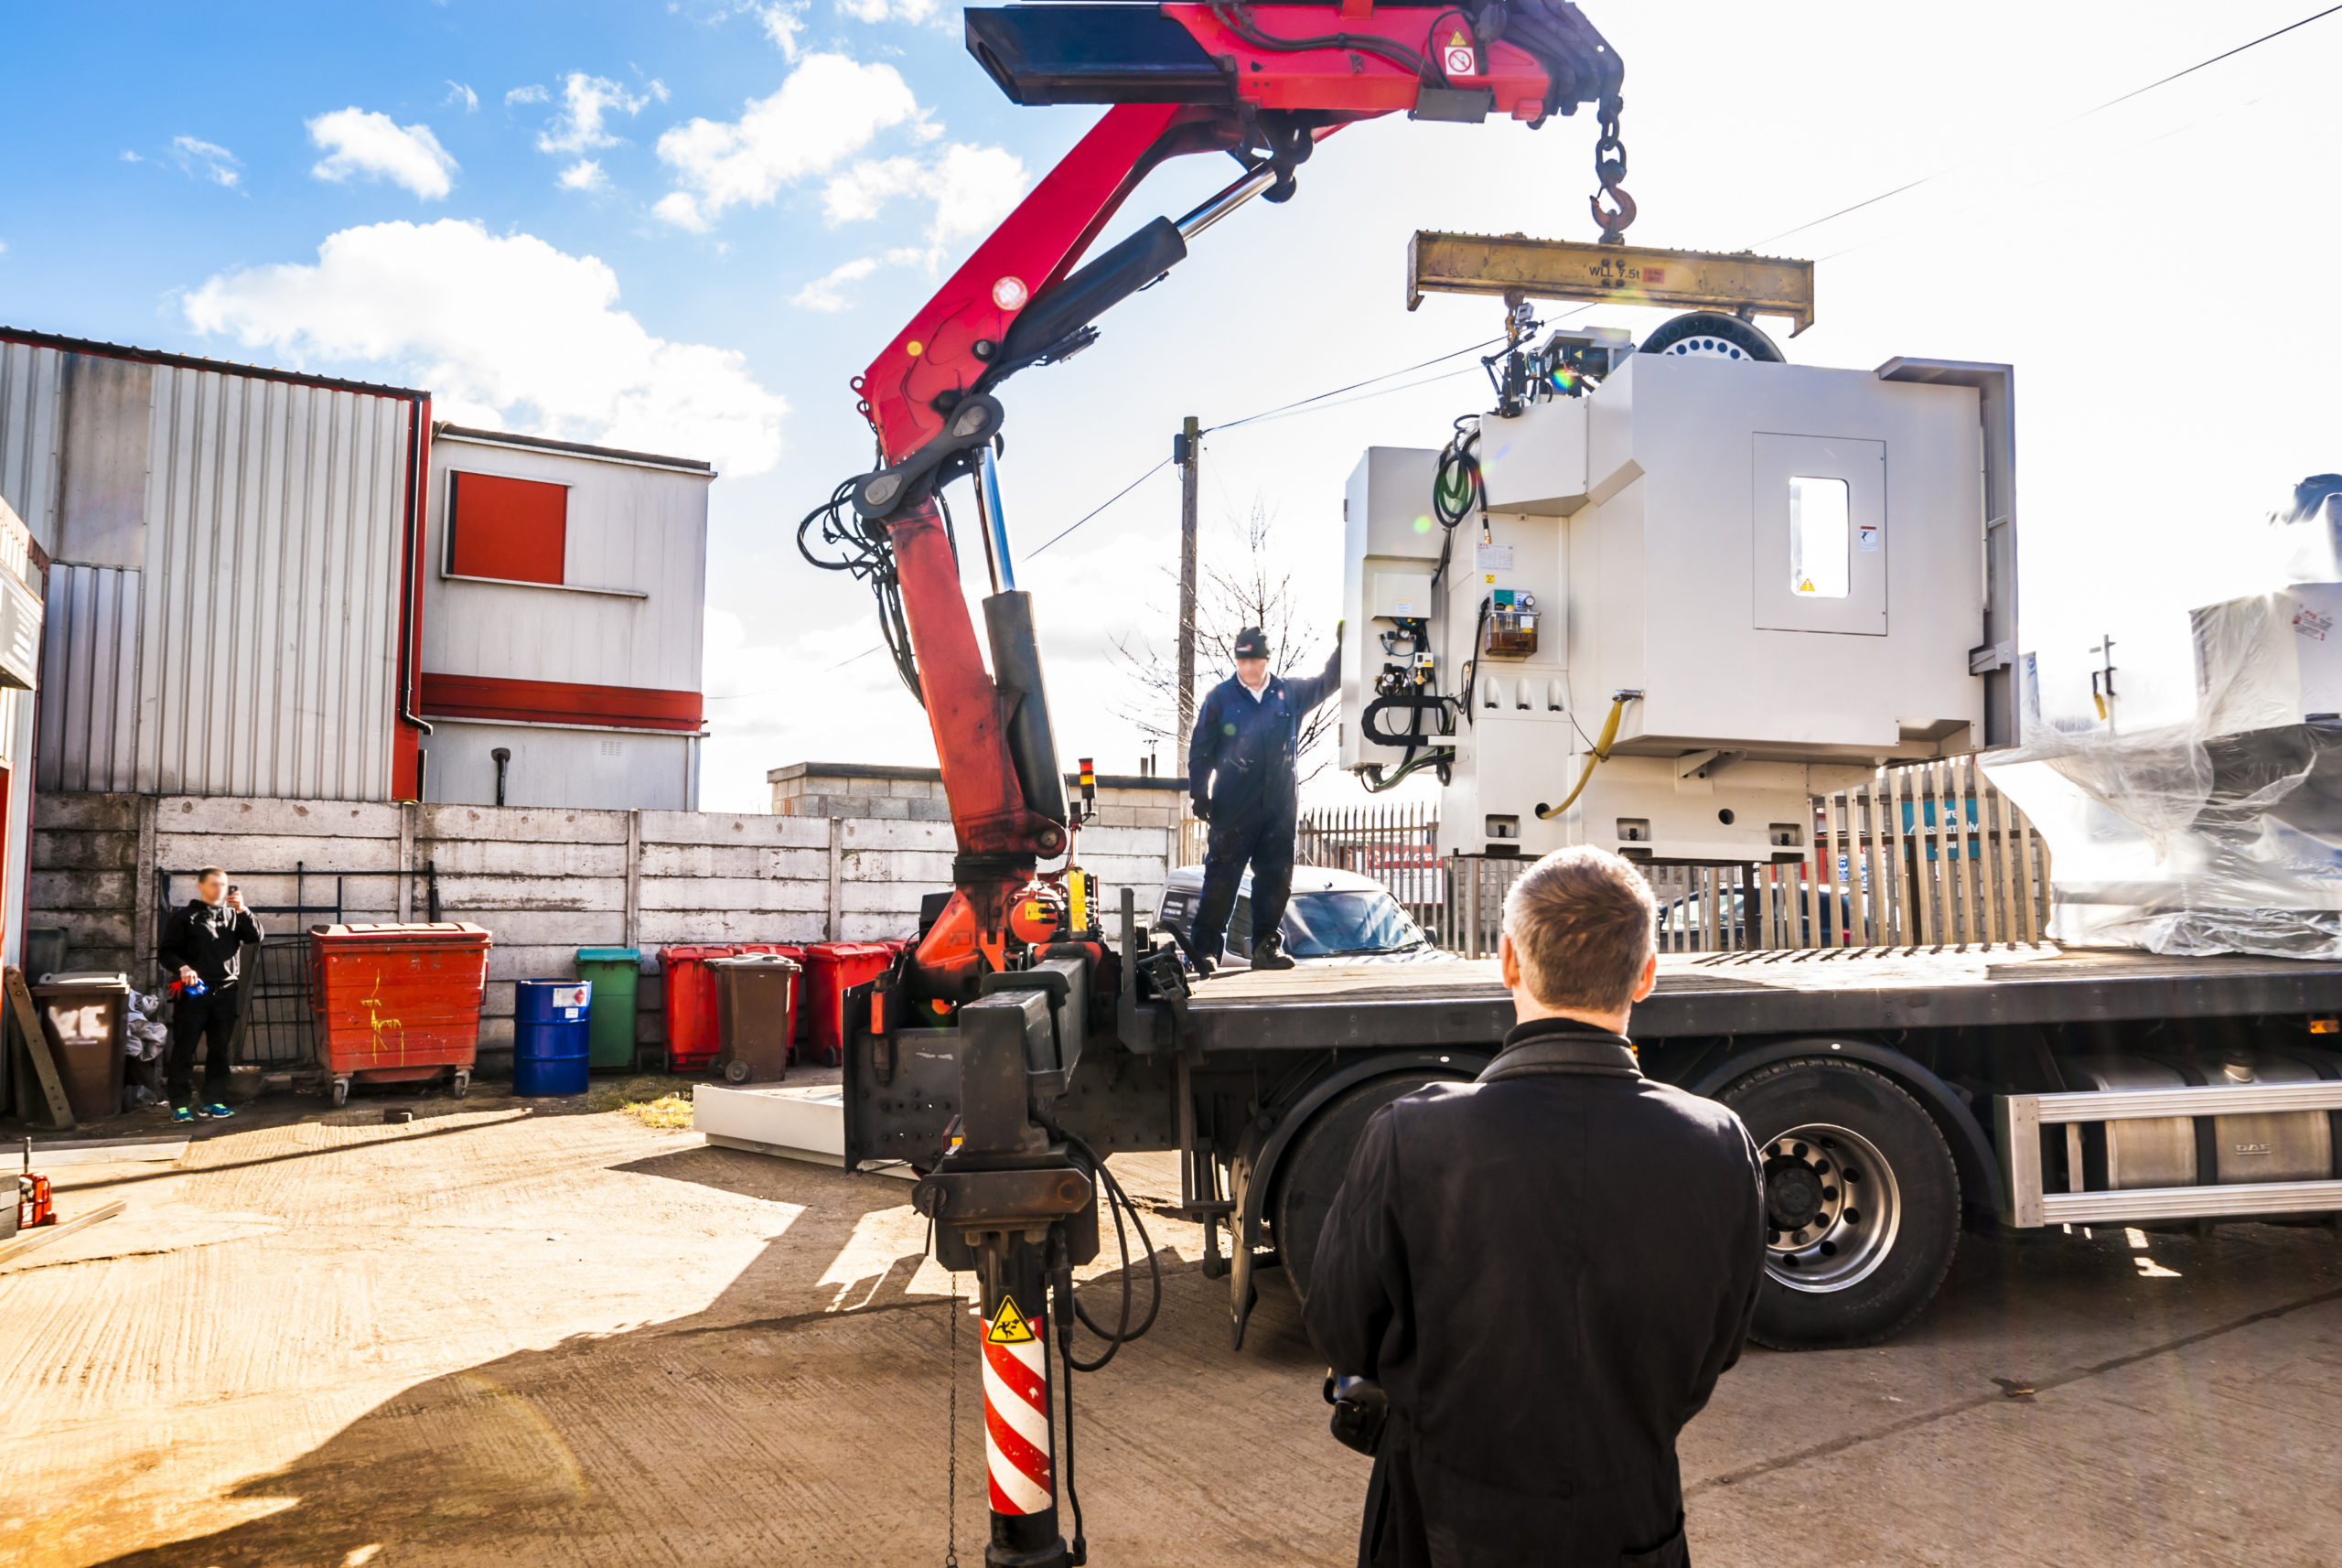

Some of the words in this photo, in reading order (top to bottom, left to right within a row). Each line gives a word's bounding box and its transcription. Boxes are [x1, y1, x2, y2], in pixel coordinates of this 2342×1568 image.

[1588, 265, 1614, 278] WLL
[1617, 266, 1640, 279] 7.5t
[1923, 820, 1980, 835] asemly
[2235, 1144, 2271, 1152] DAF
